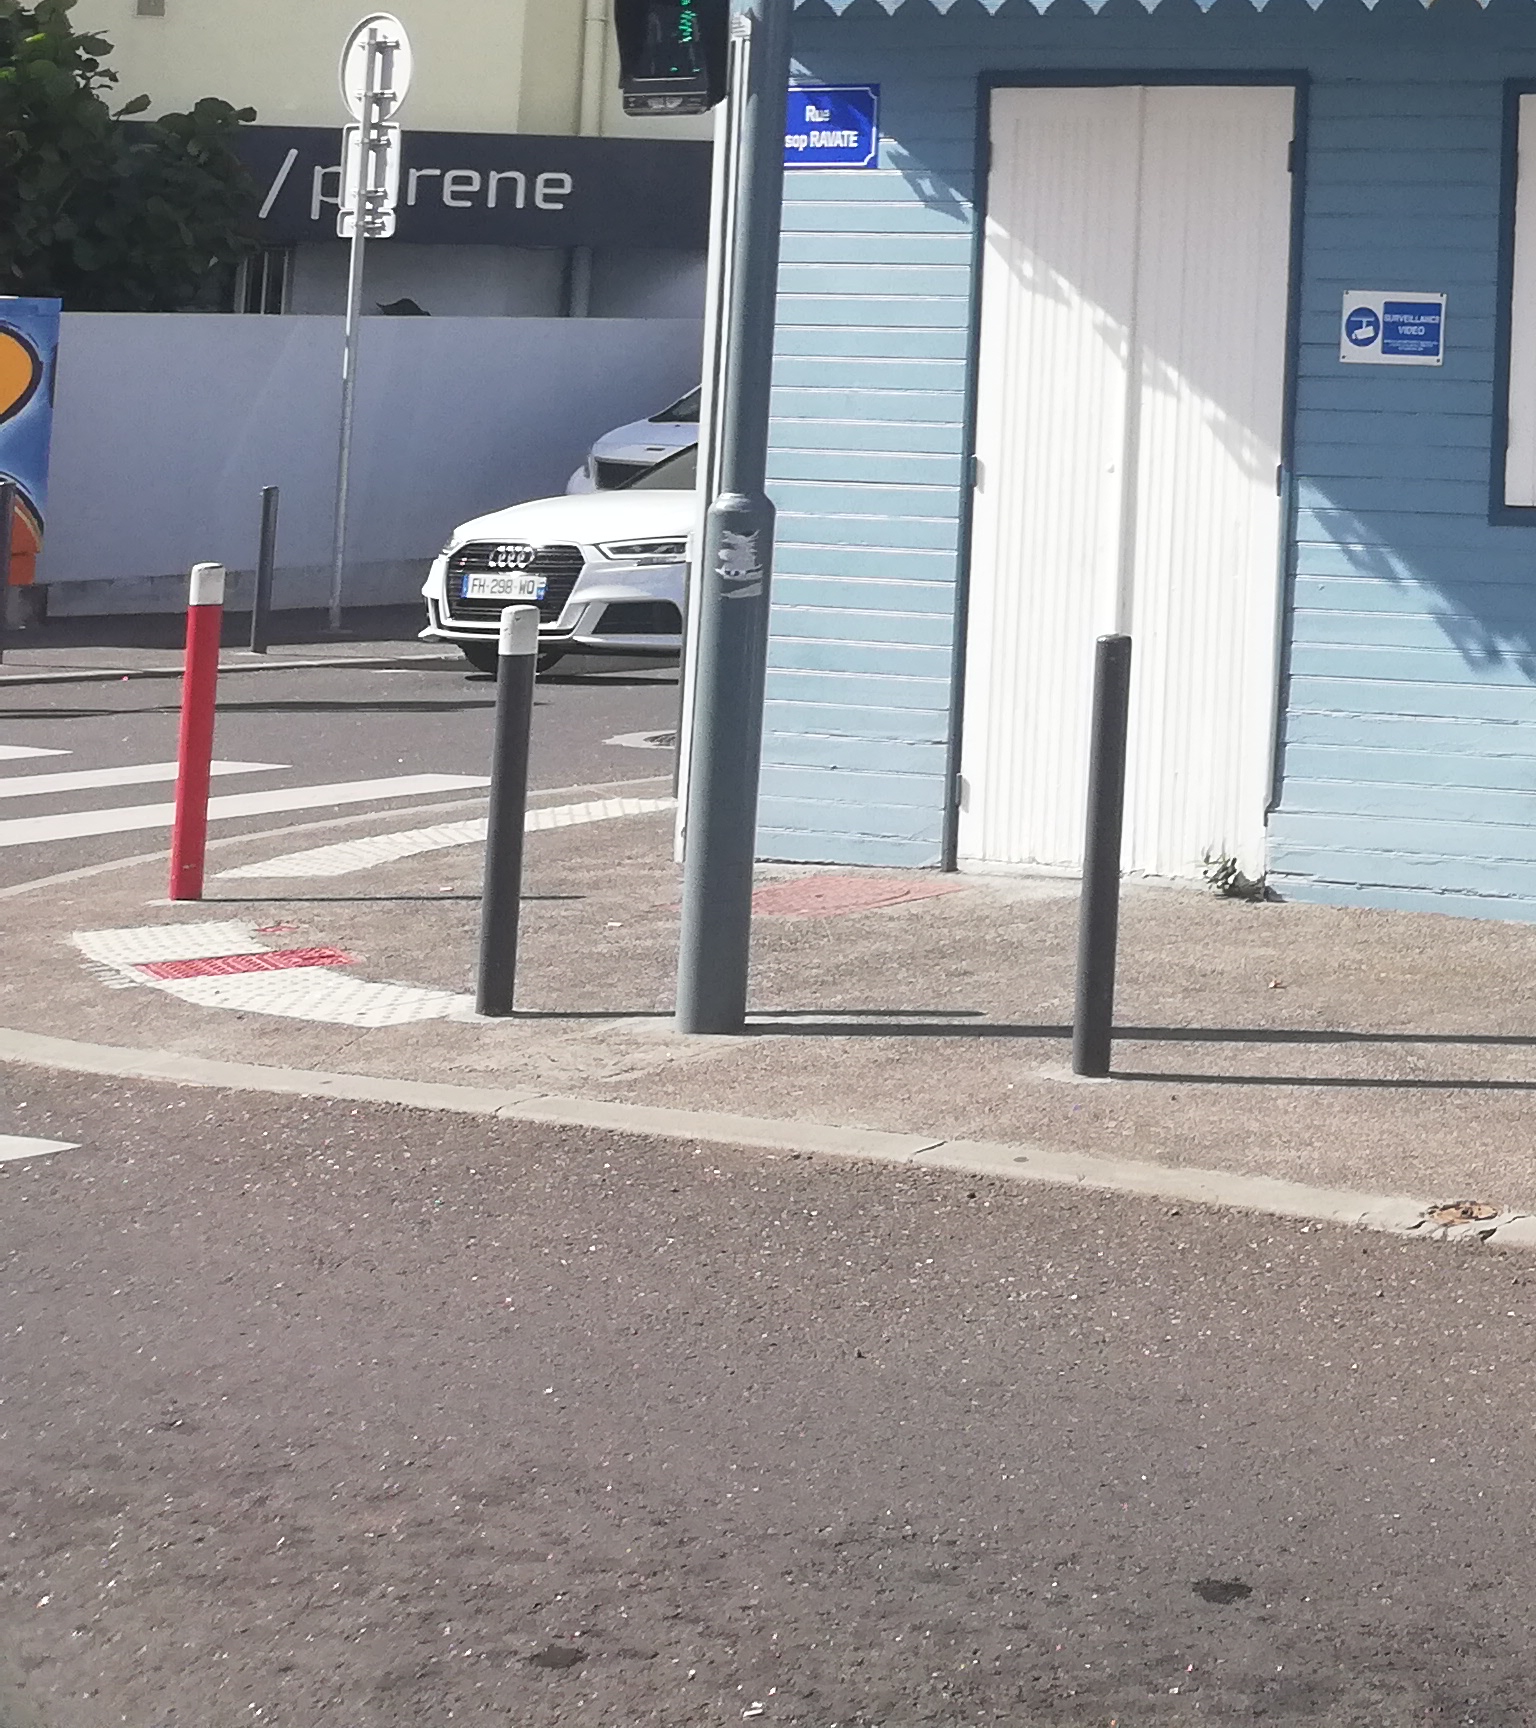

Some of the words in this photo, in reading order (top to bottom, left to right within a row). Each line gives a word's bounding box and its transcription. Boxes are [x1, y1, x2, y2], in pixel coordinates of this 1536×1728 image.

[805, 105, 831, 122] Rue
[784, 134, 808, 151] sop
[809, 130, 859, 148] RAVATE
